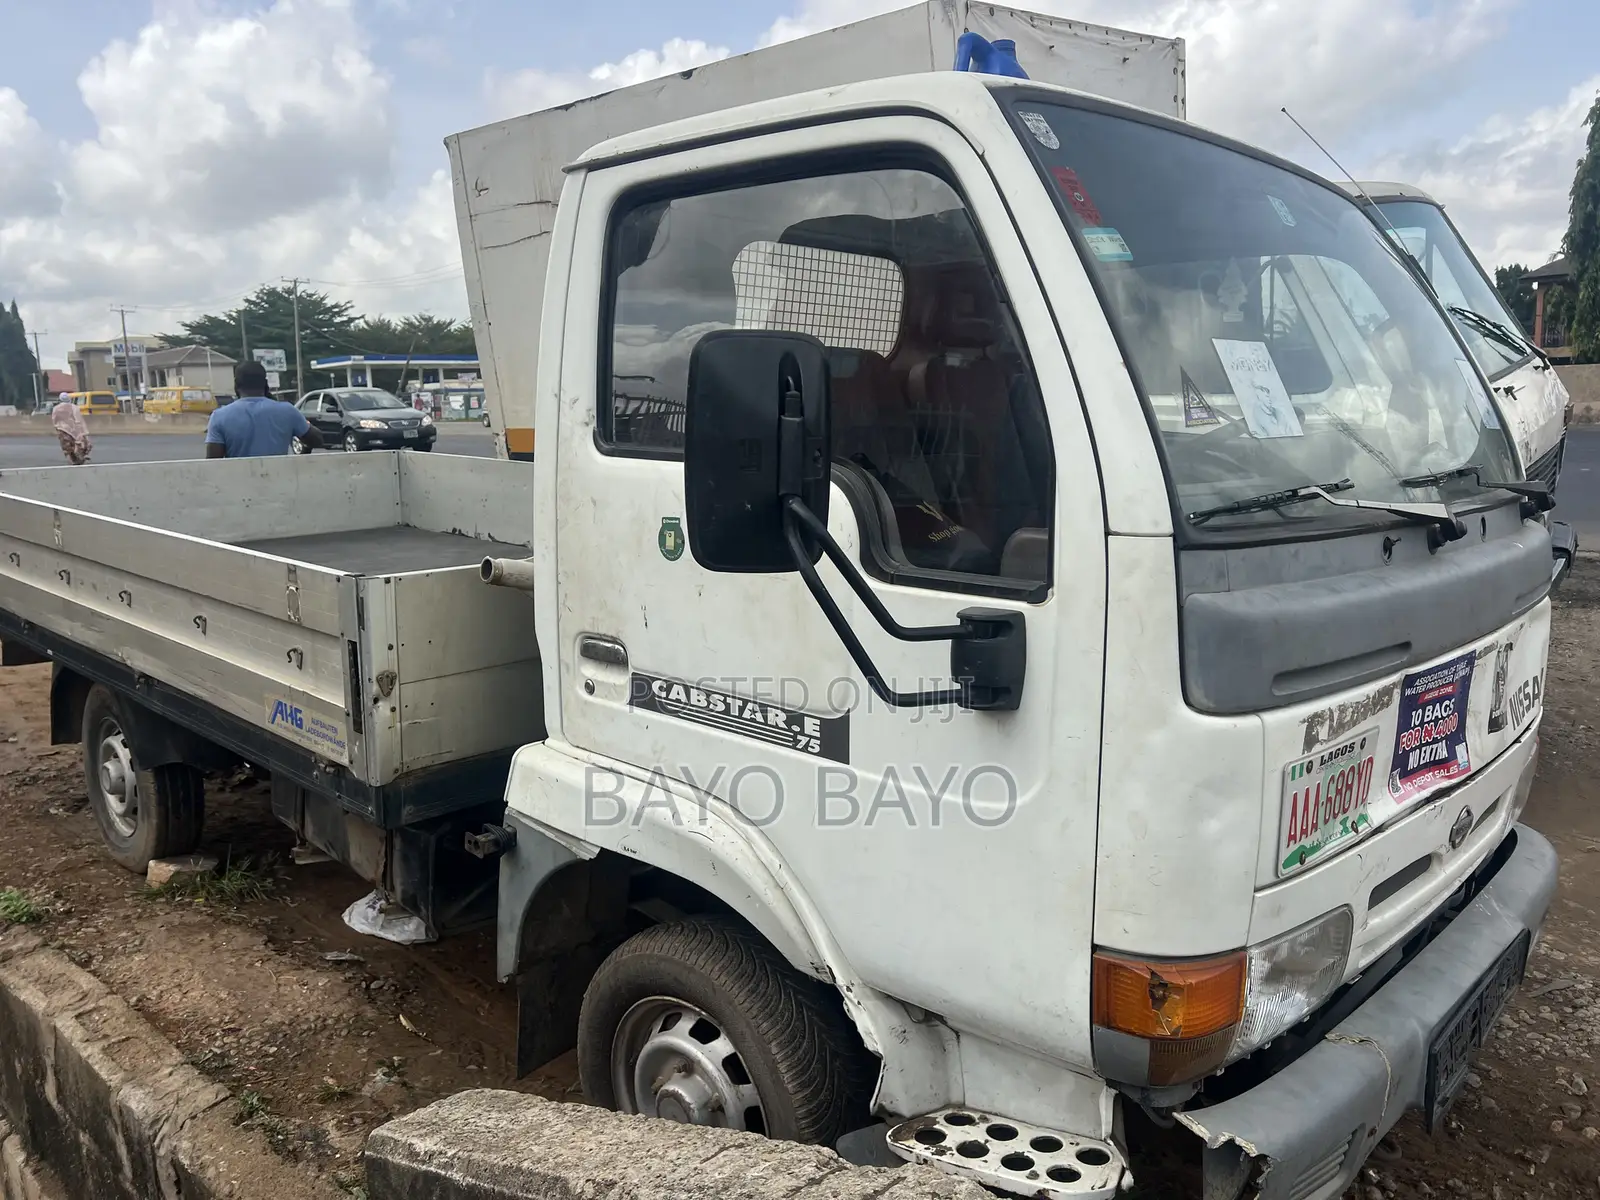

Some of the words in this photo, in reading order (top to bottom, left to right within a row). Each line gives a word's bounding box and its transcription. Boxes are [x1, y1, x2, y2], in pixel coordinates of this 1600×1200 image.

[113, 343, 145, 353] Mbil
[1405, 684, 1426, 697] WATER
[1425, 675, 1453, 691] PRODUCER
[1414, 668, 1449, 687] ASSOCIATION
[1448, 666, 1457, 677] OF
[1440, 685, 1454, 695] ZONE
[270, 699, 304, 729] AHG
[1411, 709, 1422, 727] 10
[1424, 698, 1455, 722] BAGS
[796, 735, 821, 754] 75
[1399, 727, 1421, 754] FOR
[1320, 741, 1356, 767] LAGOS
[1408, 749, 1420, 771] NO
[1420, 740, 1448, 765] EXTRA
[1403, 782, 1413, 792] NO
[1413, 773, 1434, 788] DEPOT
[1434, 765, 1459, 777] SALES
